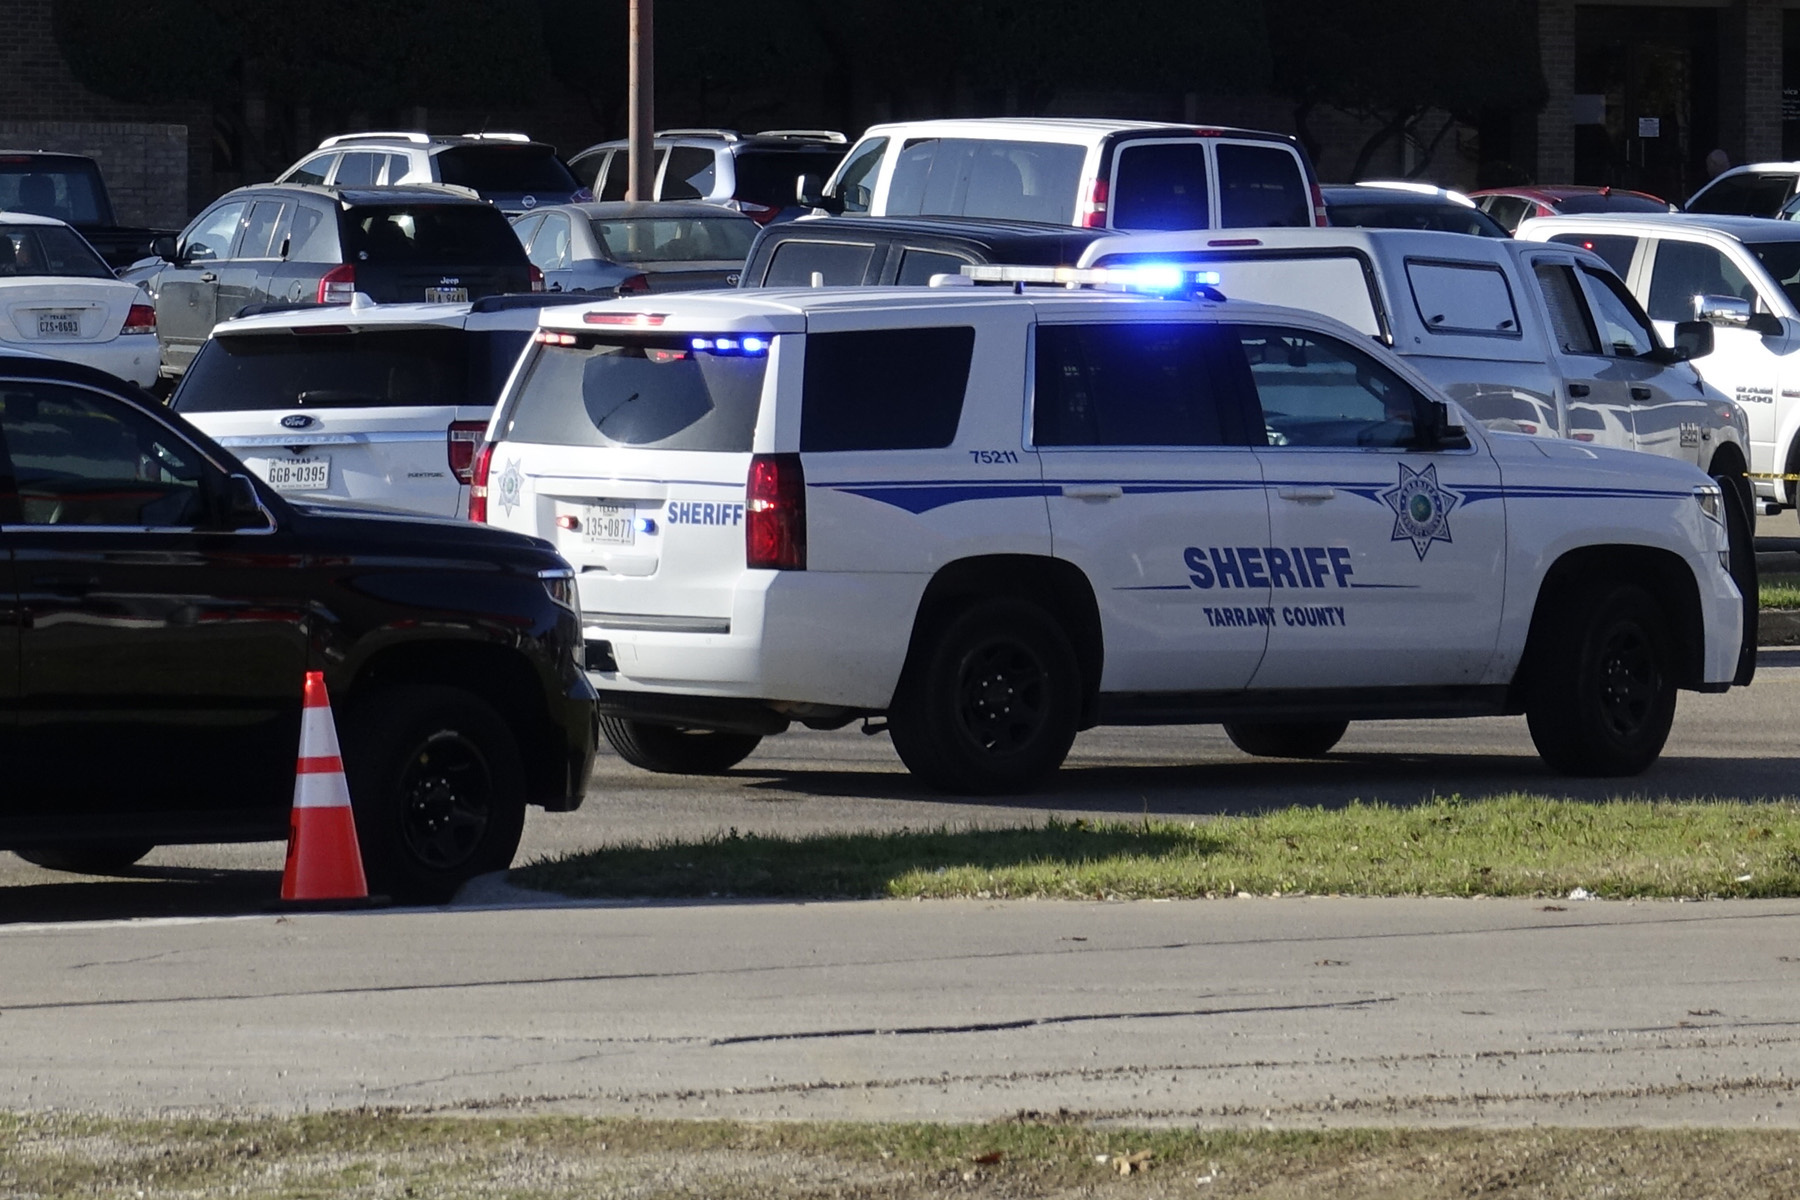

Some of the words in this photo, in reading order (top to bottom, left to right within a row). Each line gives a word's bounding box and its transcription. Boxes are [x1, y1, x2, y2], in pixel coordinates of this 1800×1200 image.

[440, 276, 459, 285] Jeep
[286, 457, 311, 466] TEXAS
[968, 450, 1019, 464] 75211
[598, 504, 619, 514] TEXAS
[667, 501, 744, 527] SHERIFF
[1183, 546, 1354, 590] SHERIFF
[1203, 606, 1278, 627] TARRANT
[1282, 606, 1347, 627] COUNTY
